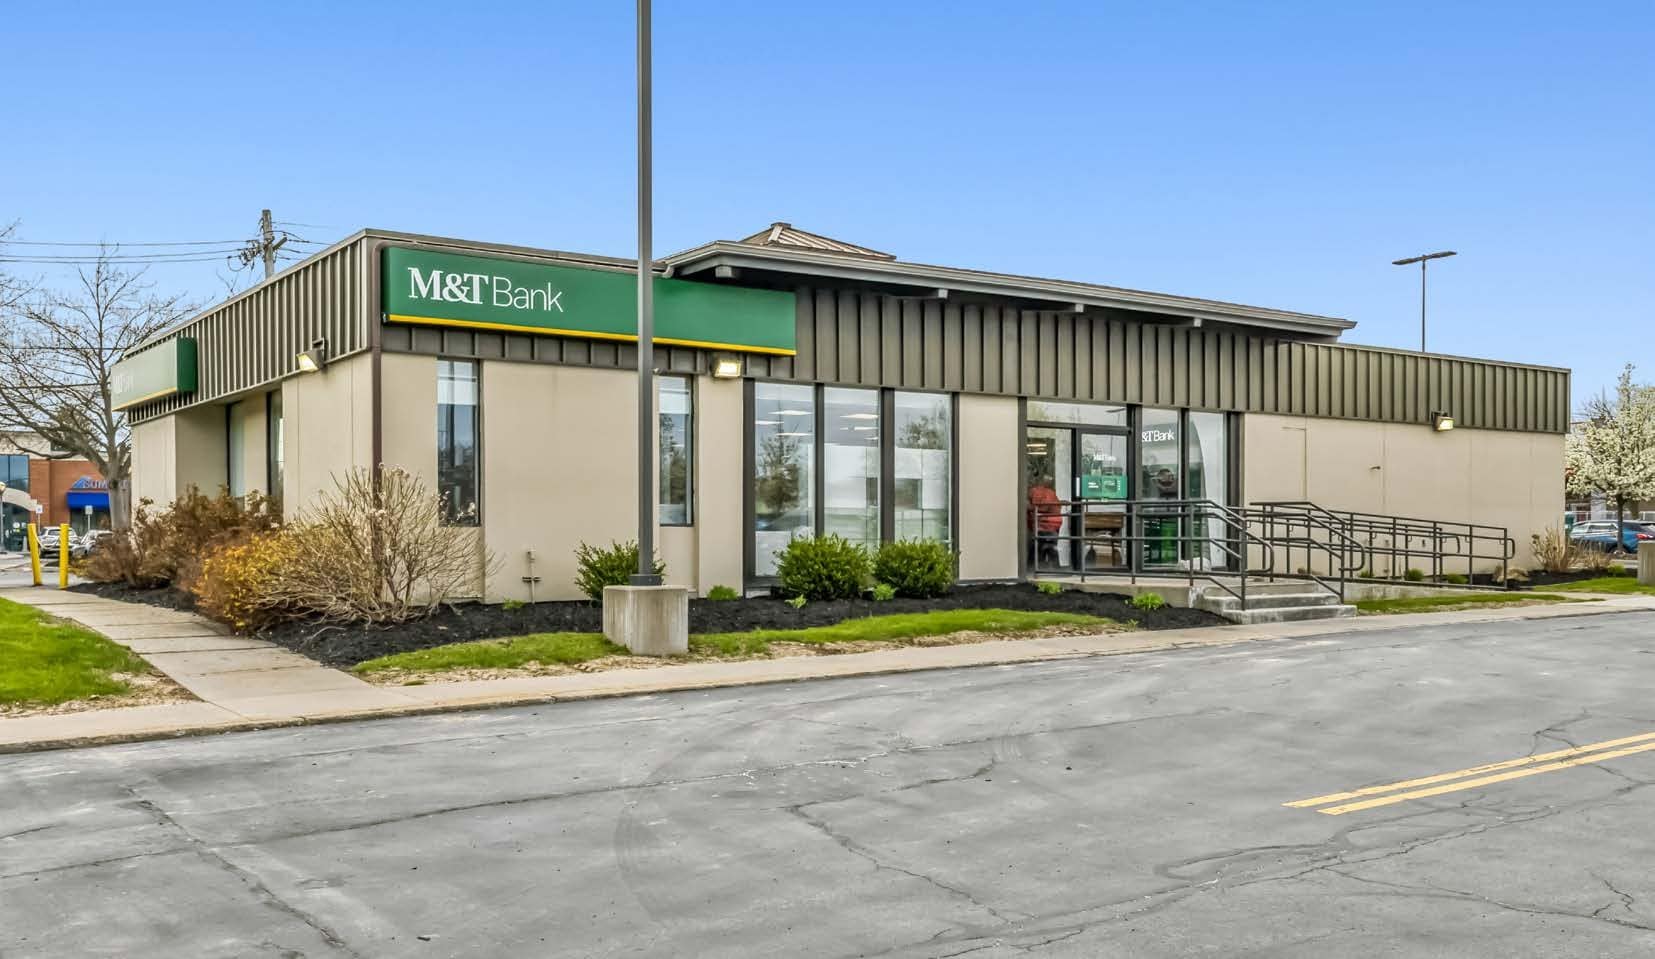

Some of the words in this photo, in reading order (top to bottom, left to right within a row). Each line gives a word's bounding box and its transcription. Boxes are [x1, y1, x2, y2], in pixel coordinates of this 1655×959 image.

[408, 267, 489, 305] M&T
[492, 275, 564, 313] Bank
[1141, 430, 1154, 443] &T
[1153, 429, 1175, 442] Bank
